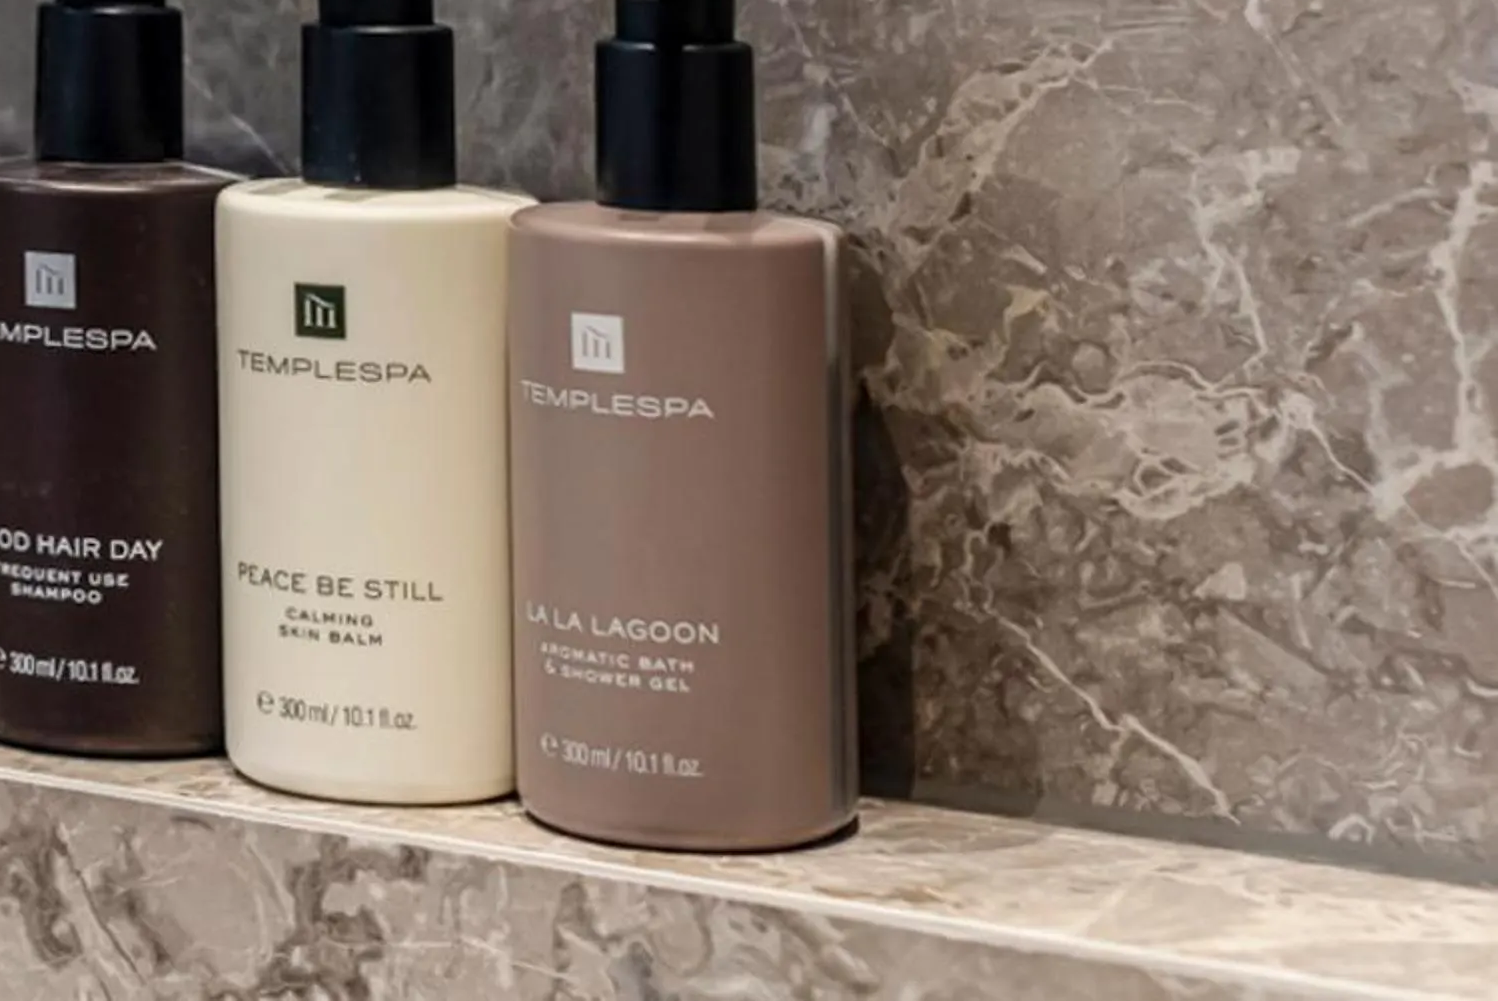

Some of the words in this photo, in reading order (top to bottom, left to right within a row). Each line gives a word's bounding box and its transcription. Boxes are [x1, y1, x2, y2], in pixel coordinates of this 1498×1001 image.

[237, 349, 432, 383] TEMPLESPA
[520, 379, 715, 420] TEMPLESPA
[36, 533, 102, 559] HAIR
[110, 539, 164, 562] DAY
[10, 581, 103, 604] SHAMPOO
[88, 572, 130, 588] USE
[238, 561, 306, 594] PEACE
[316, 574, 354, 599] BE
[364, 579, 444, 602] STILL
[285, 606, 374, 628] CALMING
[590, 615, 721, 645] LAGOON
[278, 624, 320, 642] SKIN
[329, 630, 383, 647] BALM
[540, 641, 631, 670] AROMATIC
[638, 656, 695, 673] BATH
[560, 664, 642, 689] SHOWER
[649, 676, 691, 693] GEL
